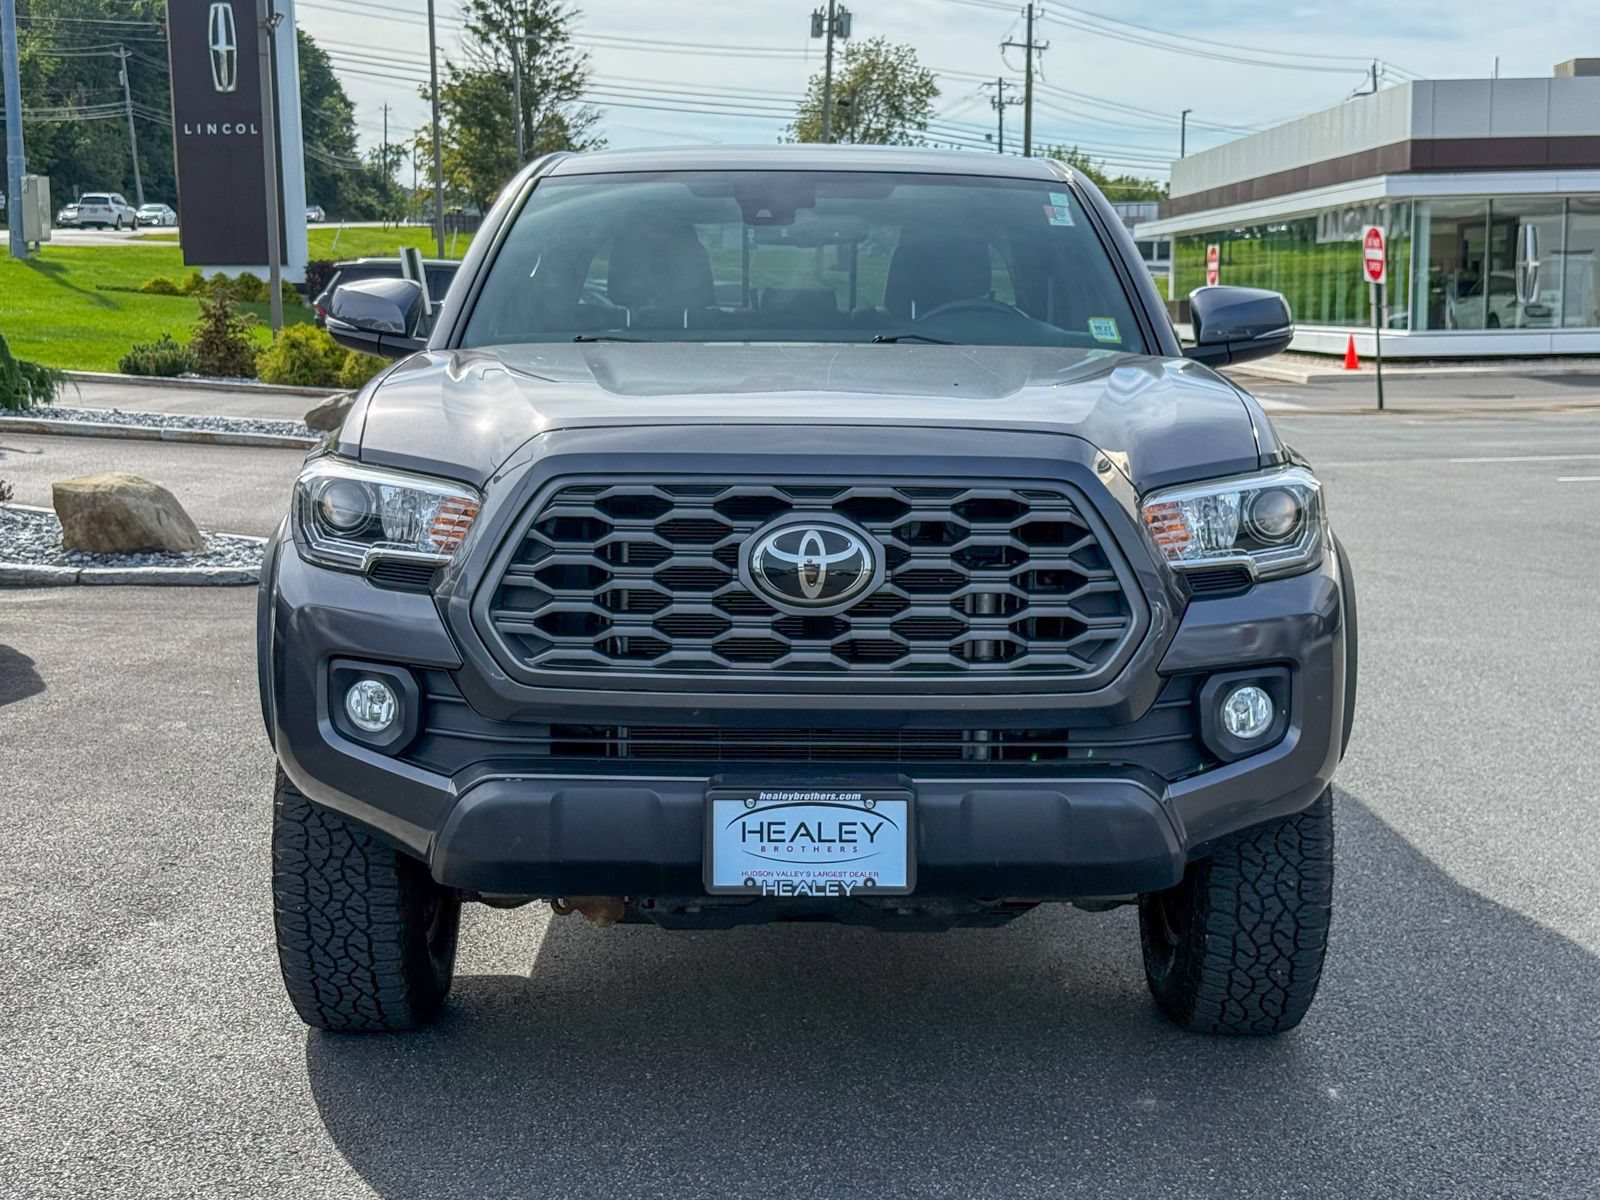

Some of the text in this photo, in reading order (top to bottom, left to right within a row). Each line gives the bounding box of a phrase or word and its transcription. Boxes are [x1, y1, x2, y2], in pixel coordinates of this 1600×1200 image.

[184, 123, 259, 135] LINCOL
[759, 791, 862, 801] healeybrothers.com
[741, 821, 884, 843] HEALEY
[760, 845, 858, 853] BROTHERS
[775, 870, 811, 878] VALLEY'S
[813, 870, 847, 878] LARGEST
[849, 870, 879, 878] DEALER
[762, 880, 857, 897] HEALEY
